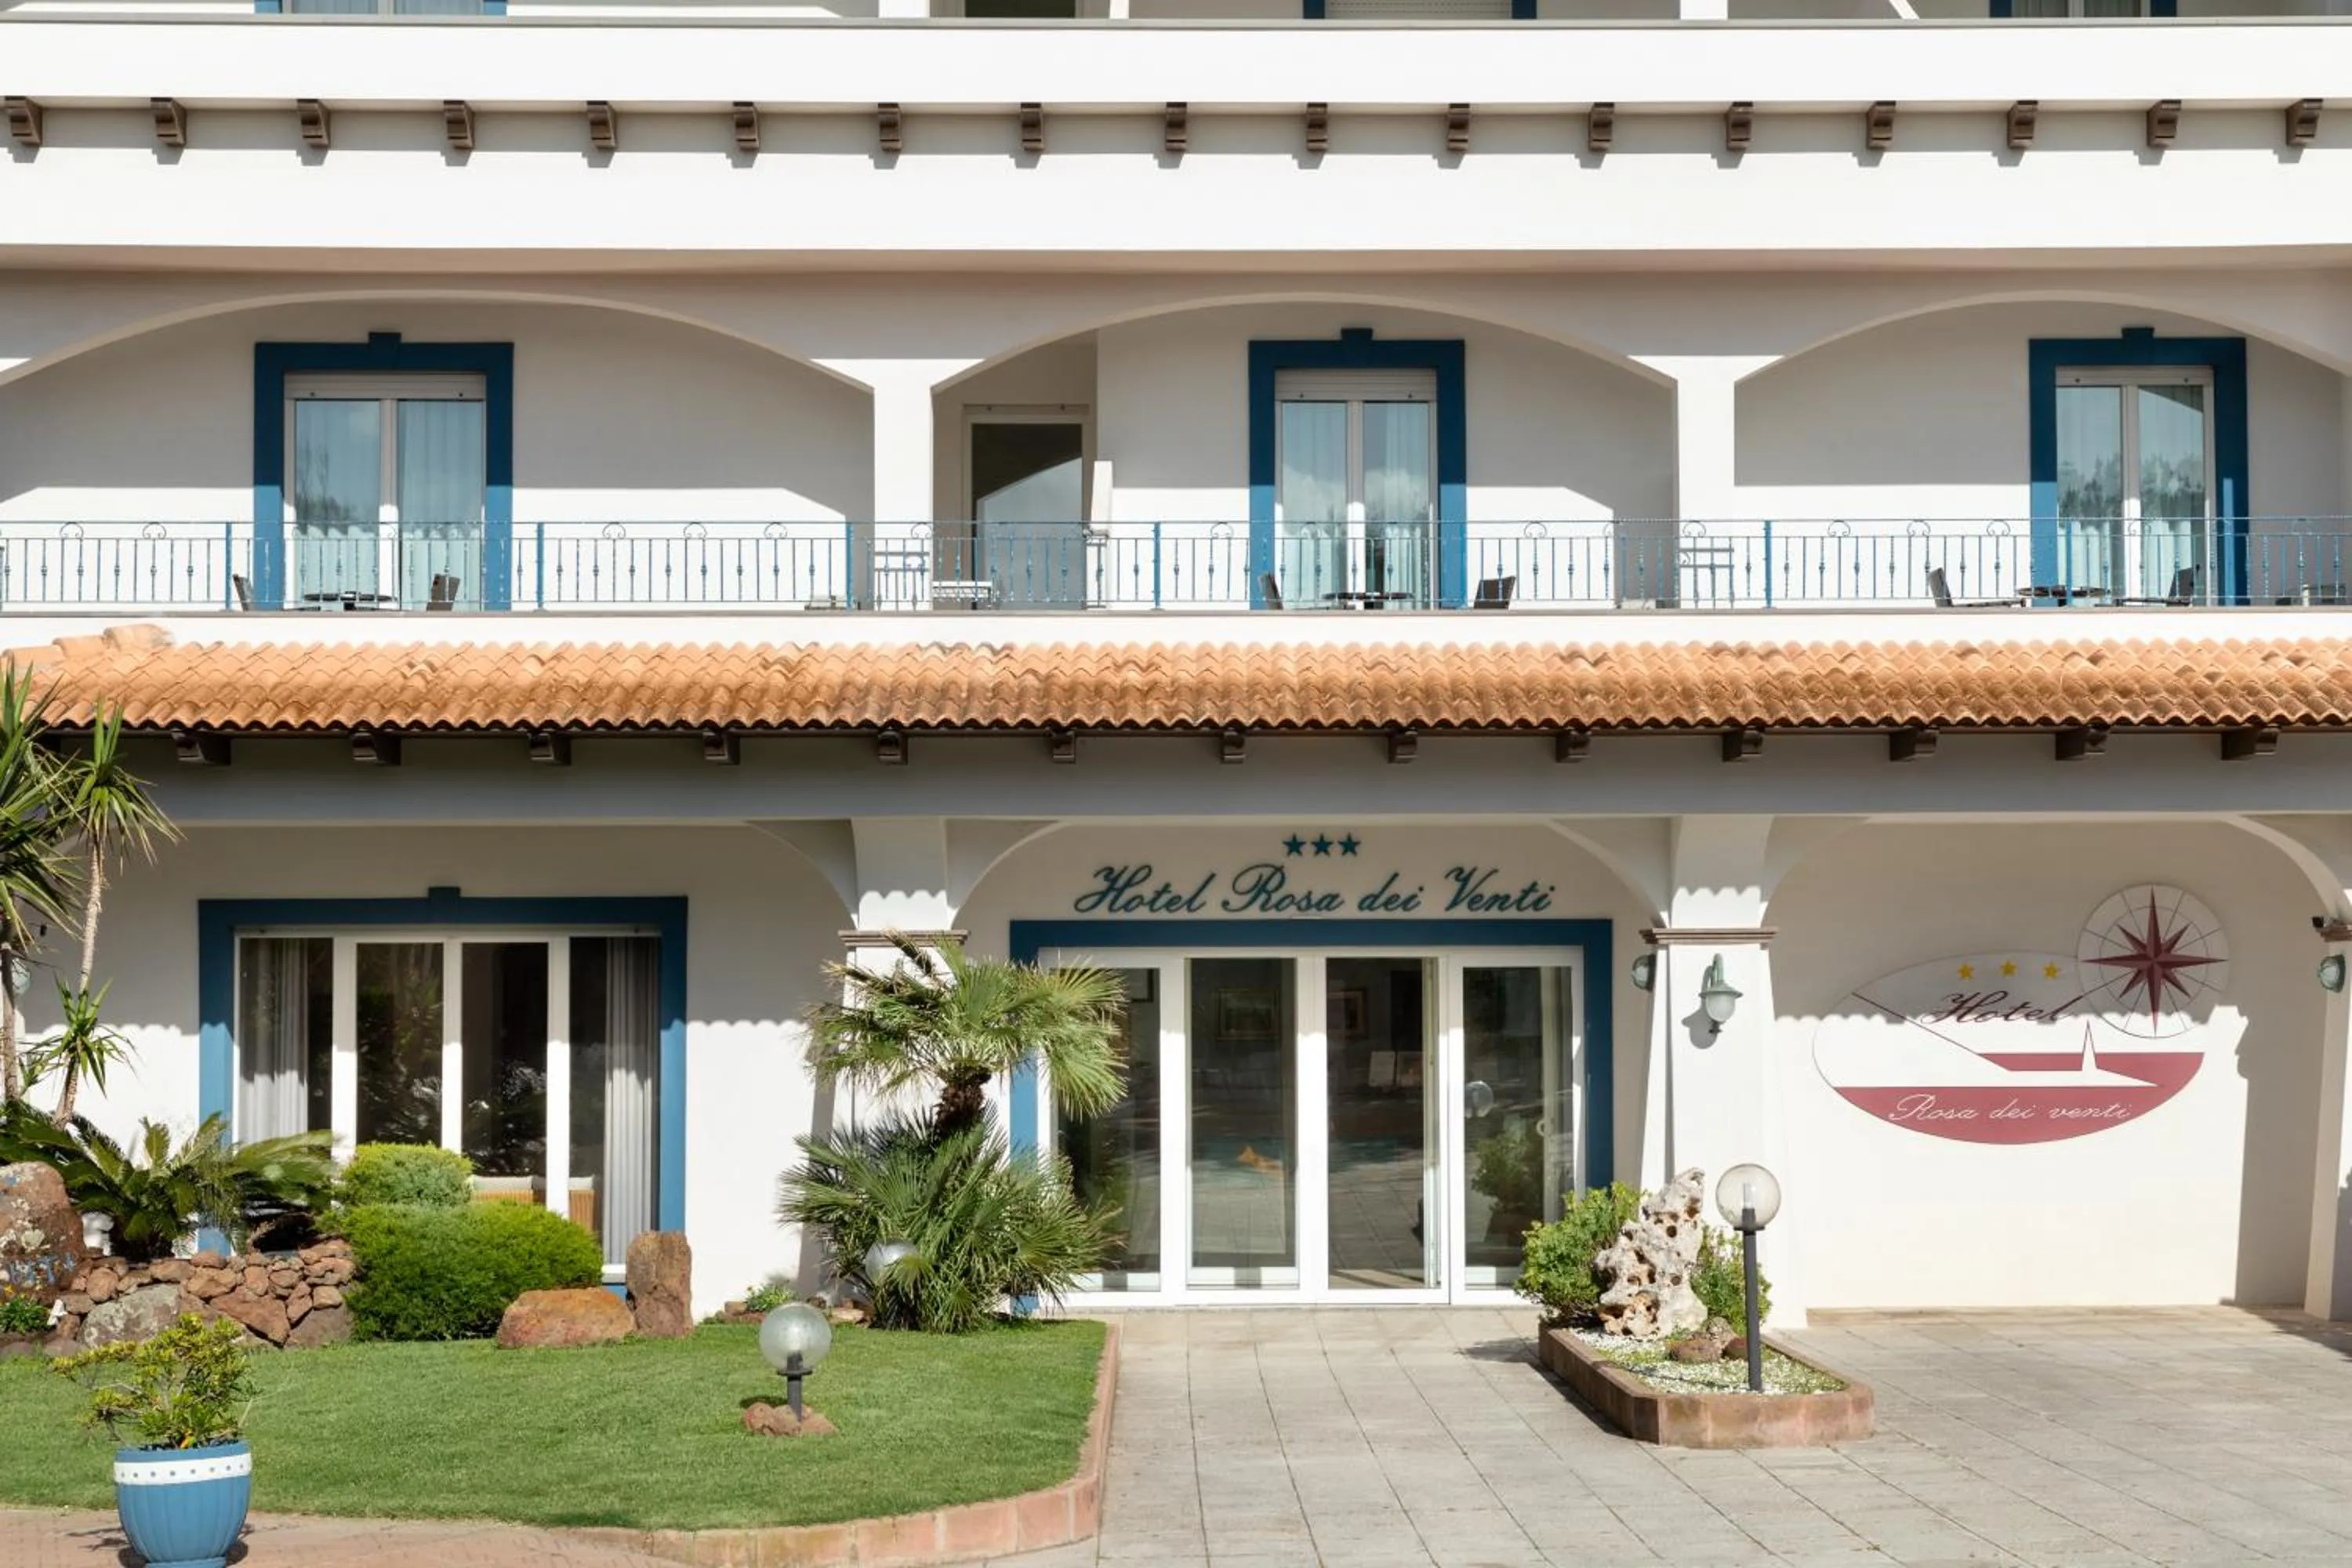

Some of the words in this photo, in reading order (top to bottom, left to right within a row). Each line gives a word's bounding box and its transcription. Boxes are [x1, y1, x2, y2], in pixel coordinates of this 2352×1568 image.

[1073, 864, 1217, 914] Hotel
[1221, 863, 1346, 913] Rosa
[1357, 872, 1425, 913] dei
[1444, 866, 1557, 913] Venti
[1920, 989, 2084, 1023] Hotel
[1888, 1093, 1980, 1121] Rosa
[1989, 1097, 2036, 1120] dei
[2049, 1102, 2132, 1120] venti
